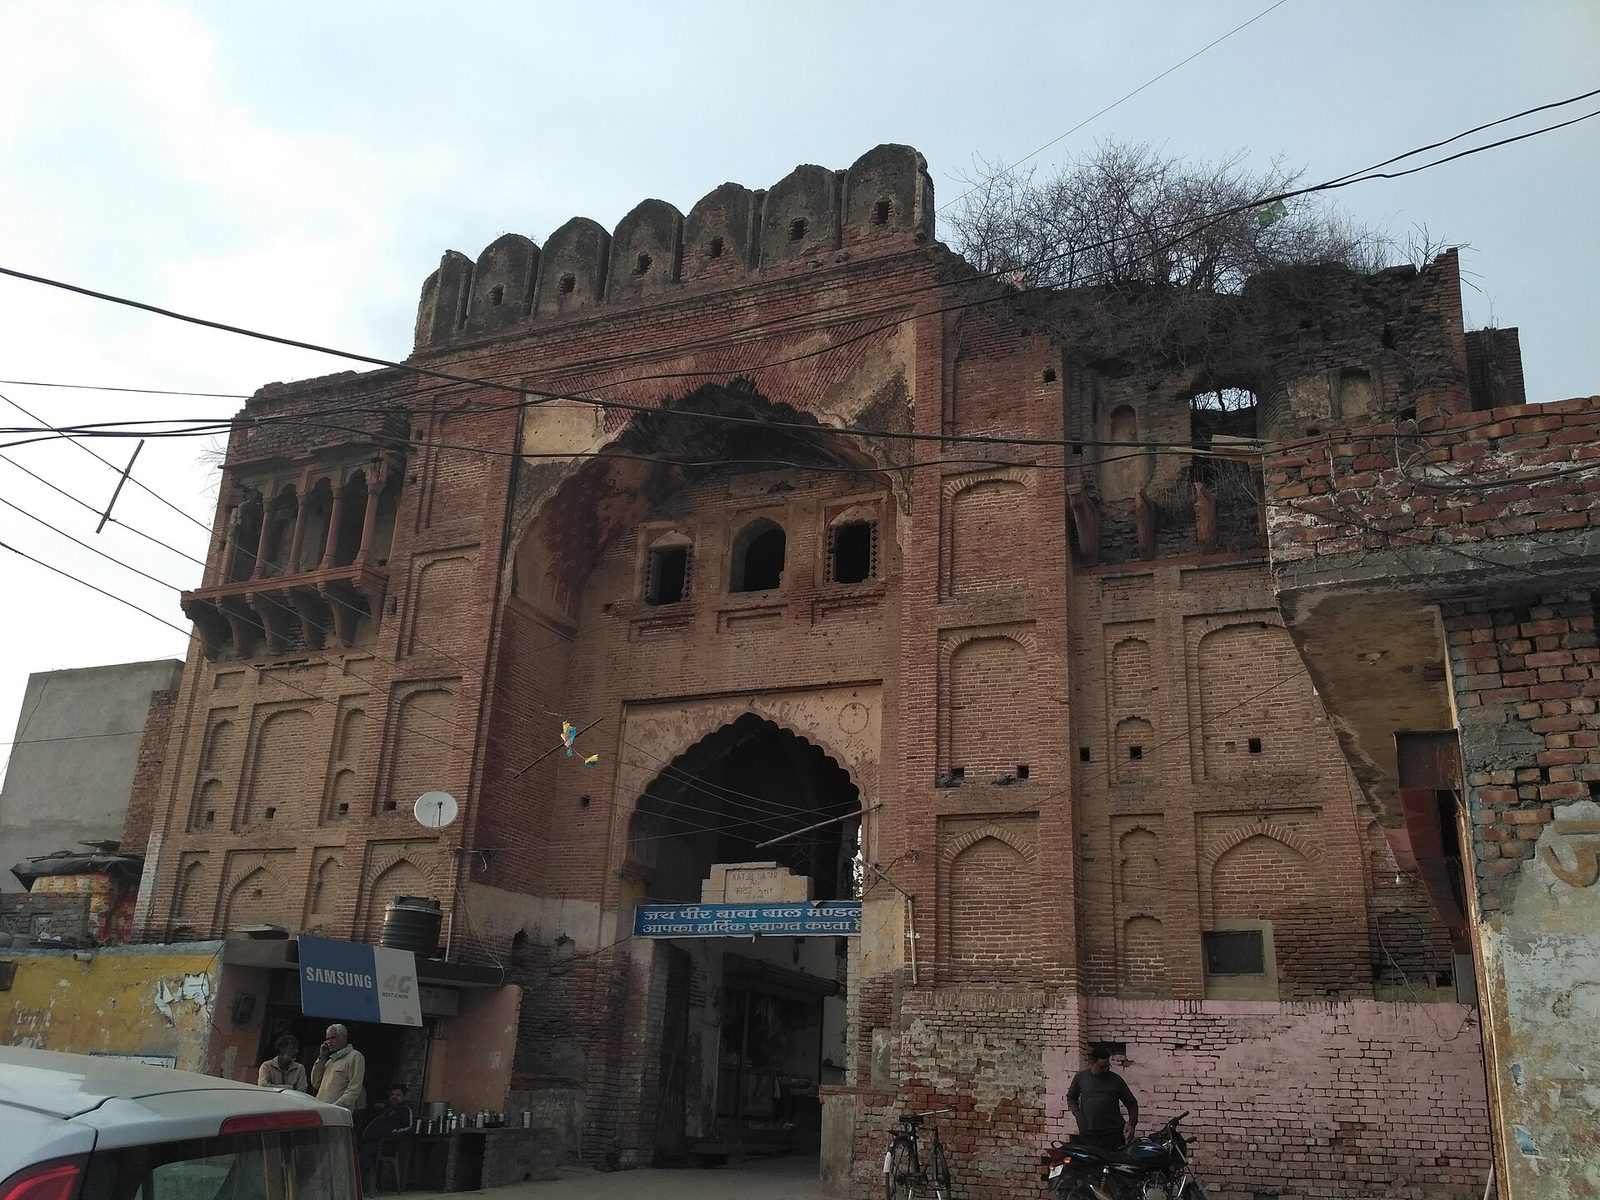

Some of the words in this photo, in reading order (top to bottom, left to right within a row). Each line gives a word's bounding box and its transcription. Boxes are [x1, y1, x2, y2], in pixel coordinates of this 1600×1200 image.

[643, 911, 676, 920] जय
[680, 907, 712, 919] पीर
[716, 909, 759, 918] बाबा
[762, 908, 802, 917] बाल
[643, 924, 694, 933] आपका
[697, 919, 746, 932] हार्दिक
[749, 922, 802, 931] स्वागत
[805, 921, 851, 930] करता
[306, 966, 372, 988] SAMSUNG
[383, 974, 413, 993] 4G
